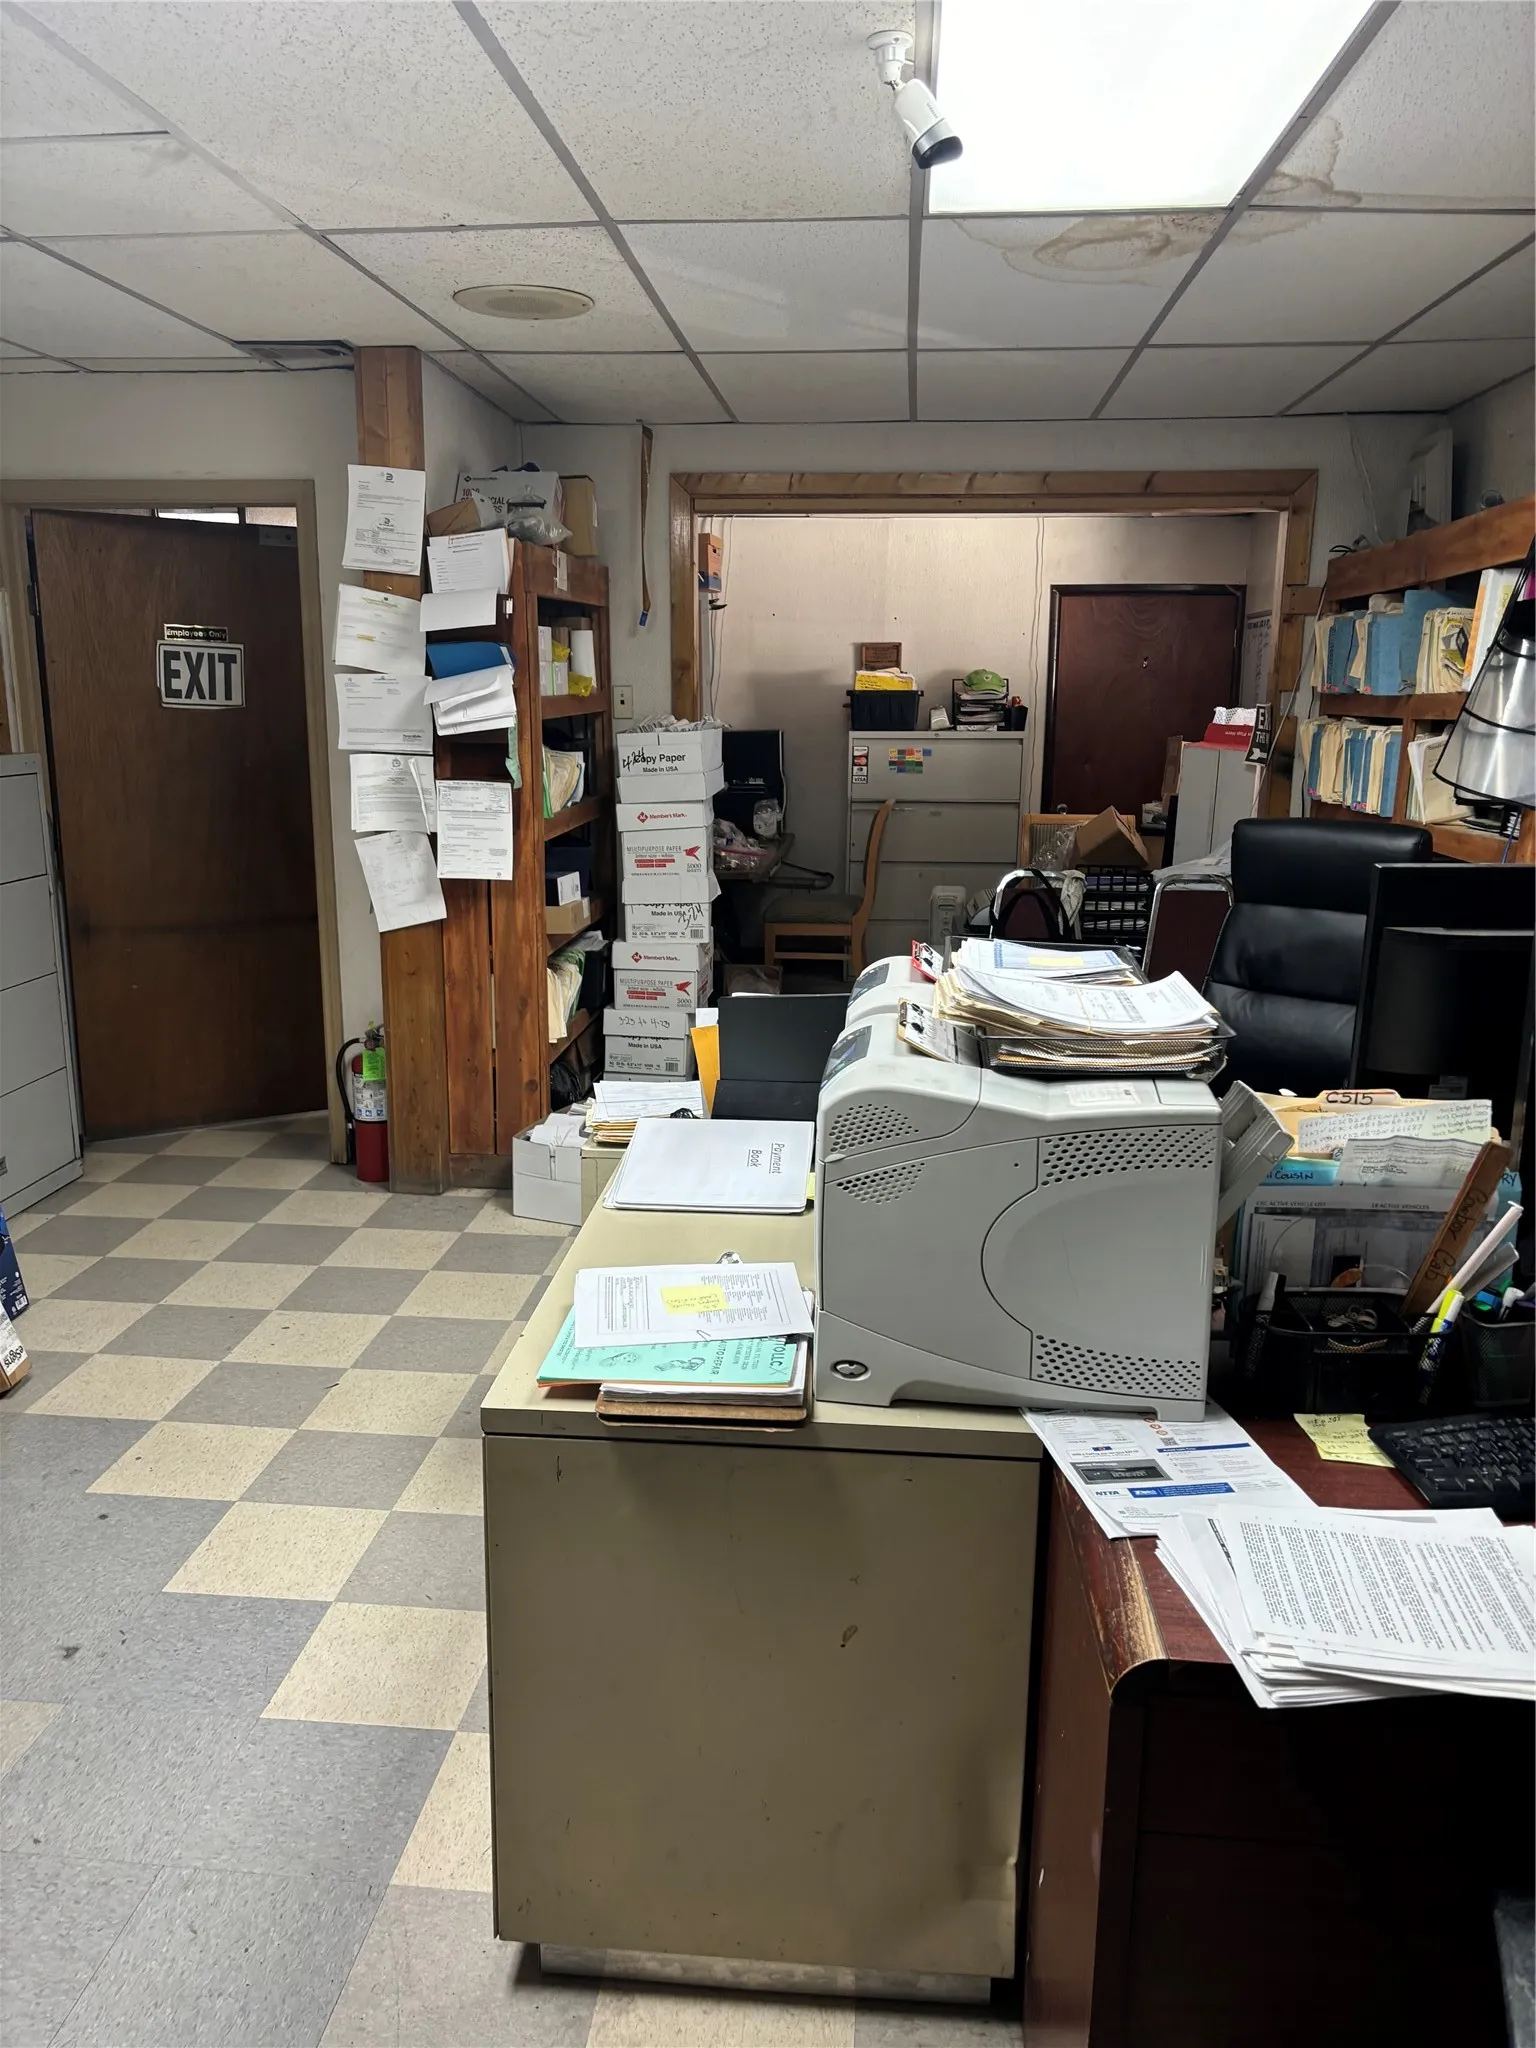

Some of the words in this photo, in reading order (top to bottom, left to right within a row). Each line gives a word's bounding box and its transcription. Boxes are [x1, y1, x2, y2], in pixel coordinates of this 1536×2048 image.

[166, 628, 207, 638] Employees
[163, 650, 237, 701] EXIT
[634, 755, 657, 764] Copy
[659, 754, 686, 763] Paper
[649, 812, 672, 820] Member's
[619, 978, 657, 986] MULTIPURPOSE
[750, 1149, 762, 1168] Book
[771, 1142, 785, 1174] Payment
[1501, 1173, 1517, 1187] RY
[1448, 1188, 1489, 1240] Cowboy
[1424, 1249, 1457, 1281] Cab
